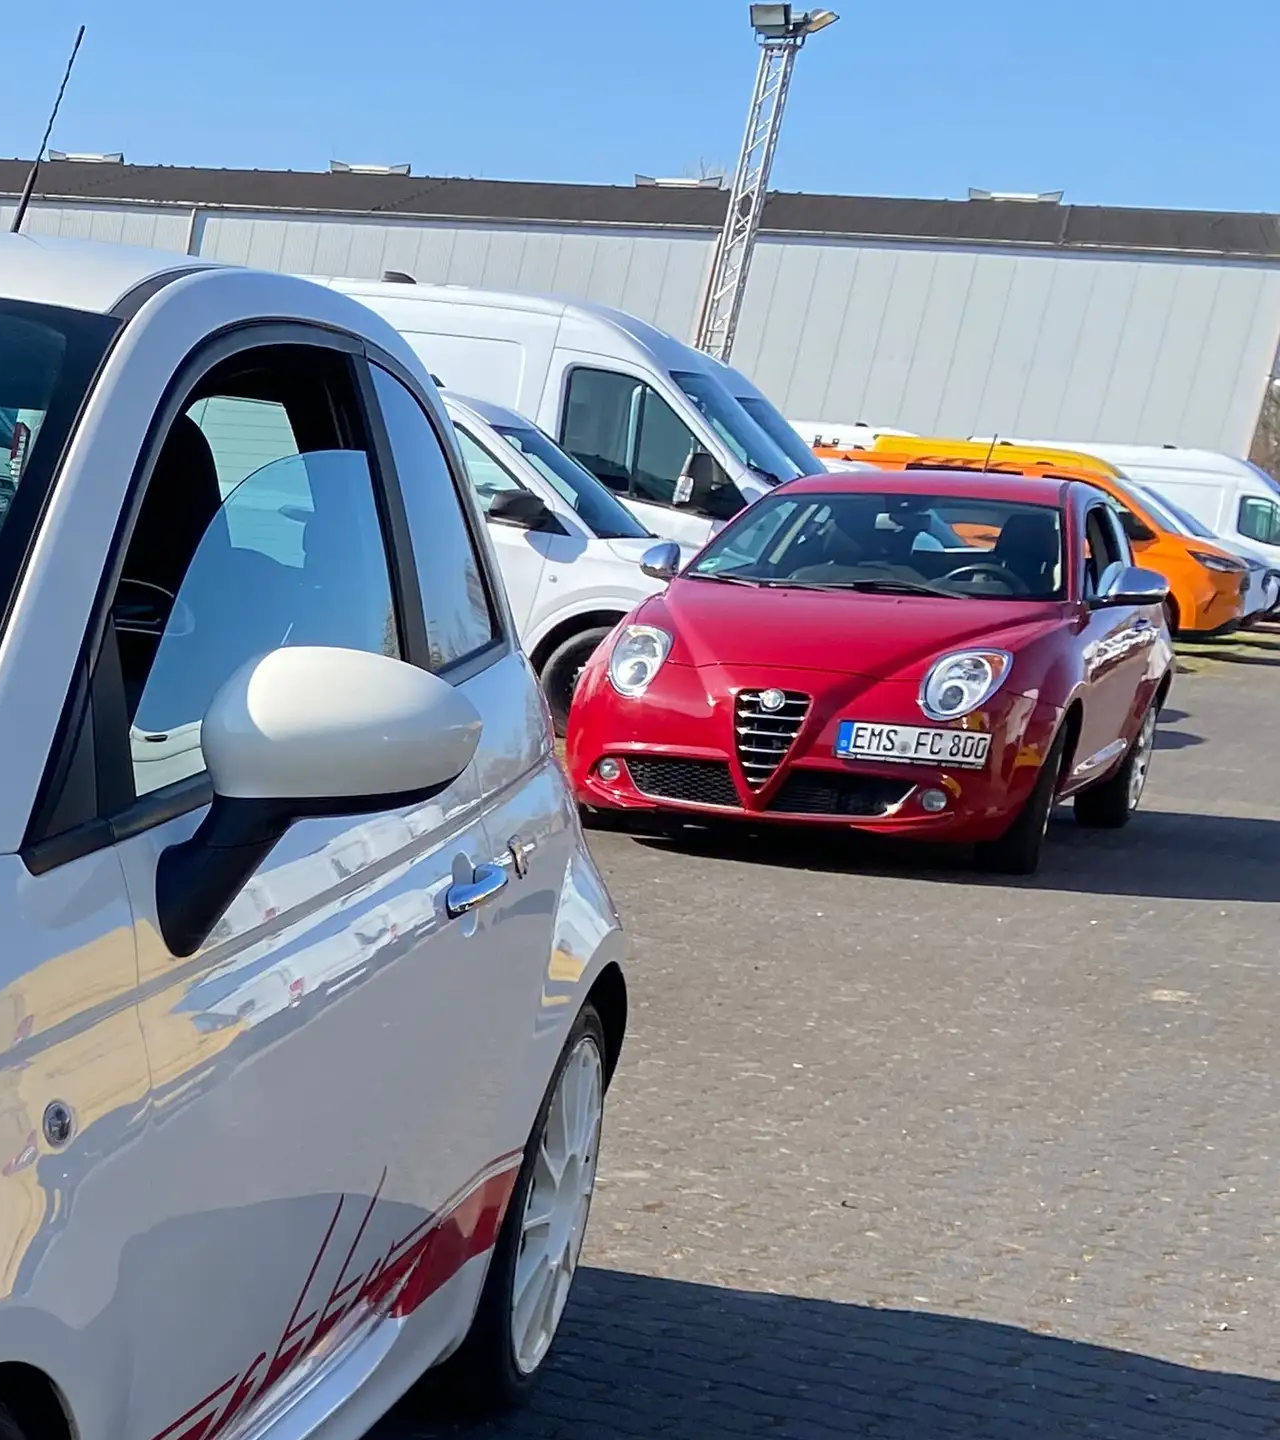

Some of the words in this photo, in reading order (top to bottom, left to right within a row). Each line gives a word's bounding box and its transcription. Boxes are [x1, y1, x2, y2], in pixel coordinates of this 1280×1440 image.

[852, 727, 898, 752] EMS
[914, 732, 943, 755] FC
[949, 735, 988, 759] 800
